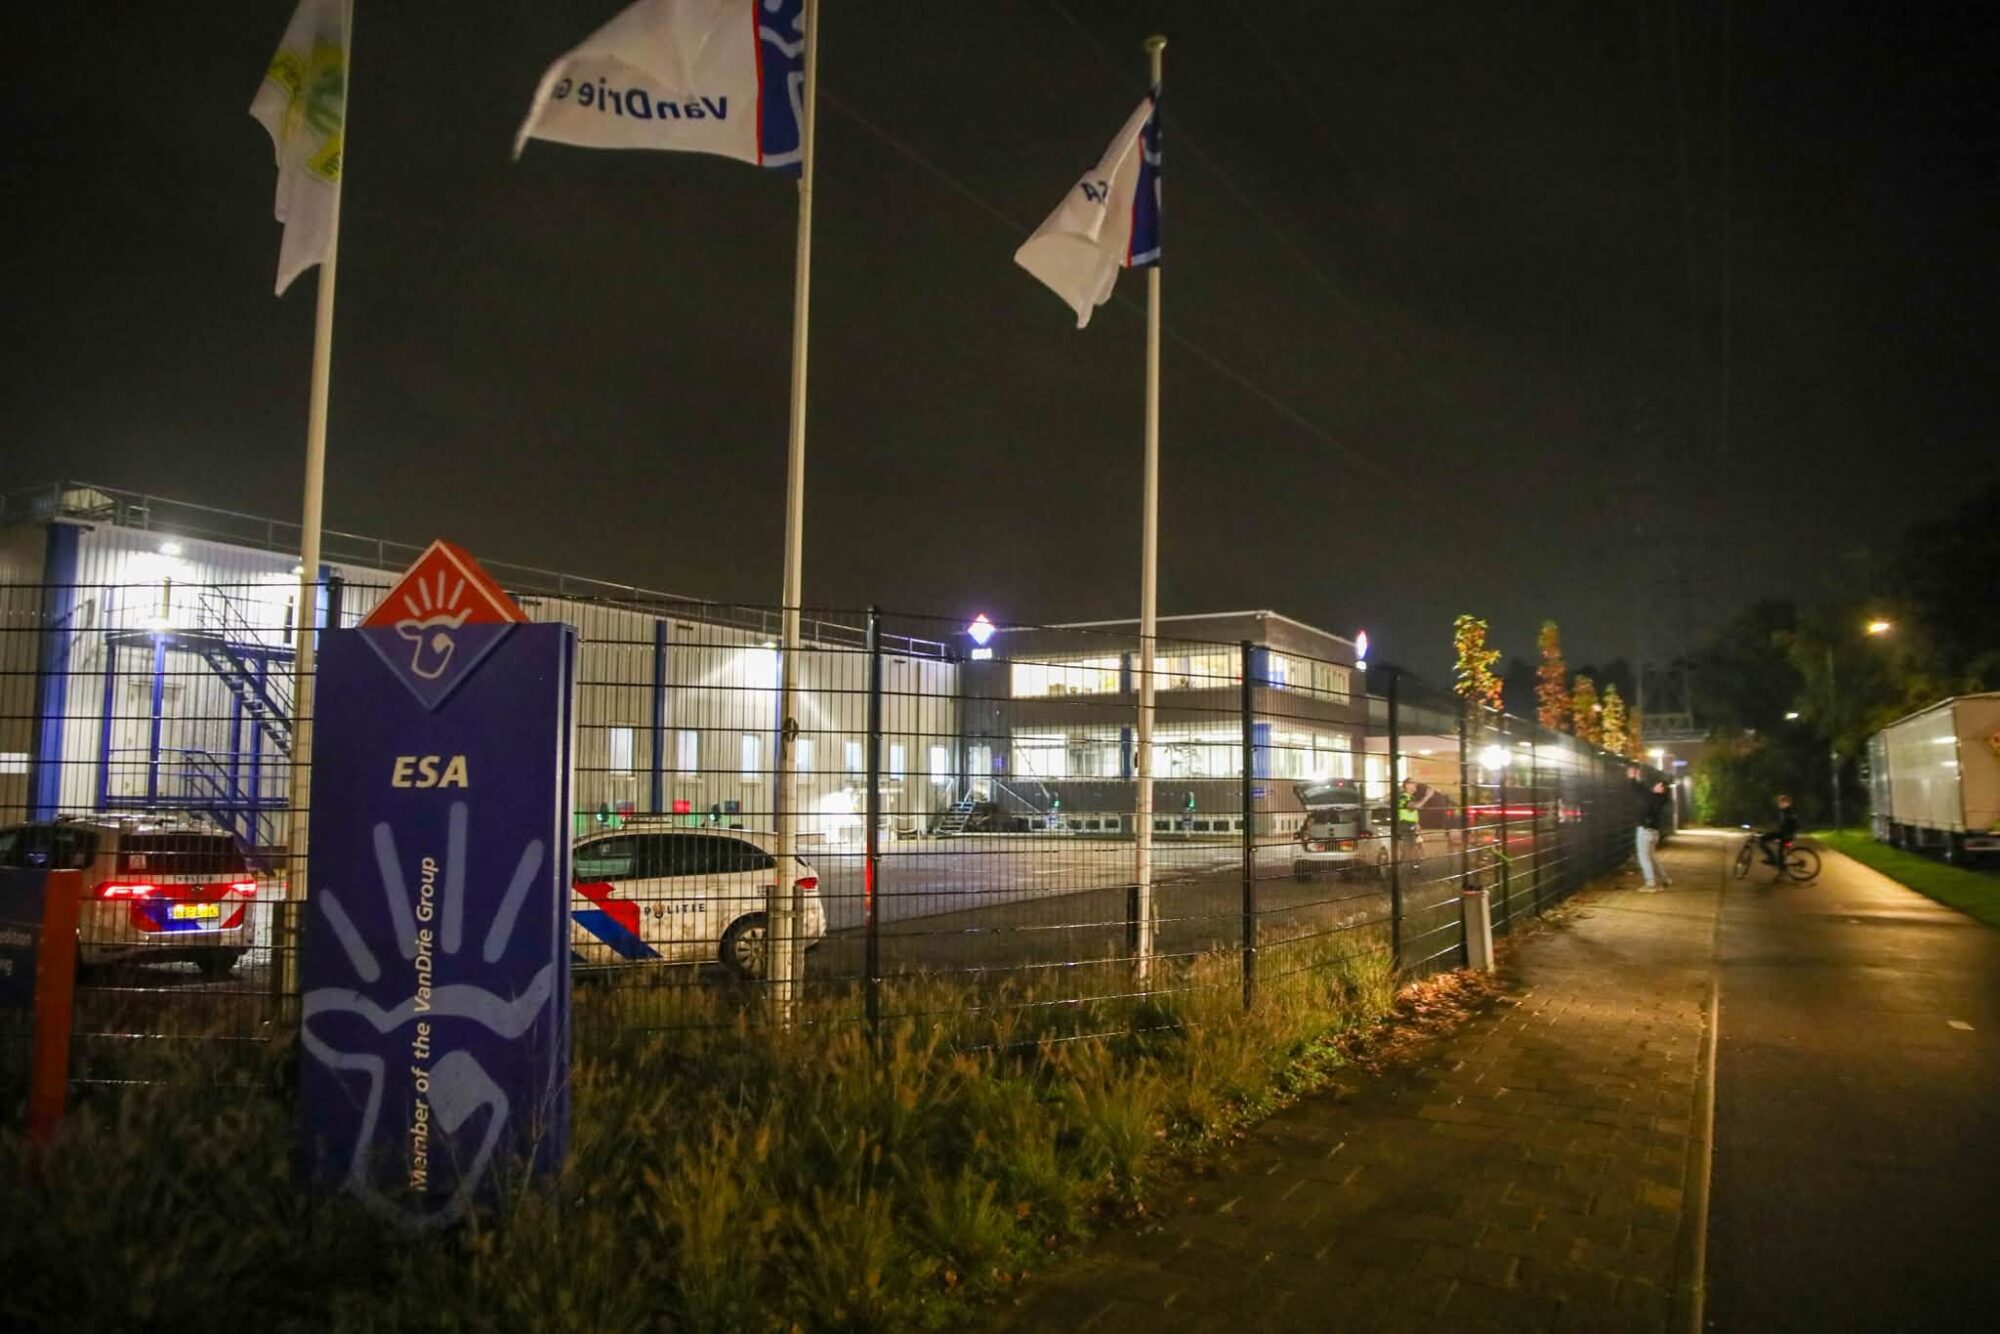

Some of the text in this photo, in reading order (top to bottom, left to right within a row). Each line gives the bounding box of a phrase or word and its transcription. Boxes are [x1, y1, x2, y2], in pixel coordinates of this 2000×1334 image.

[391, 754, 468, 788] ESA
[411, 857, 439, 1191] Member of the VanDrie Group
